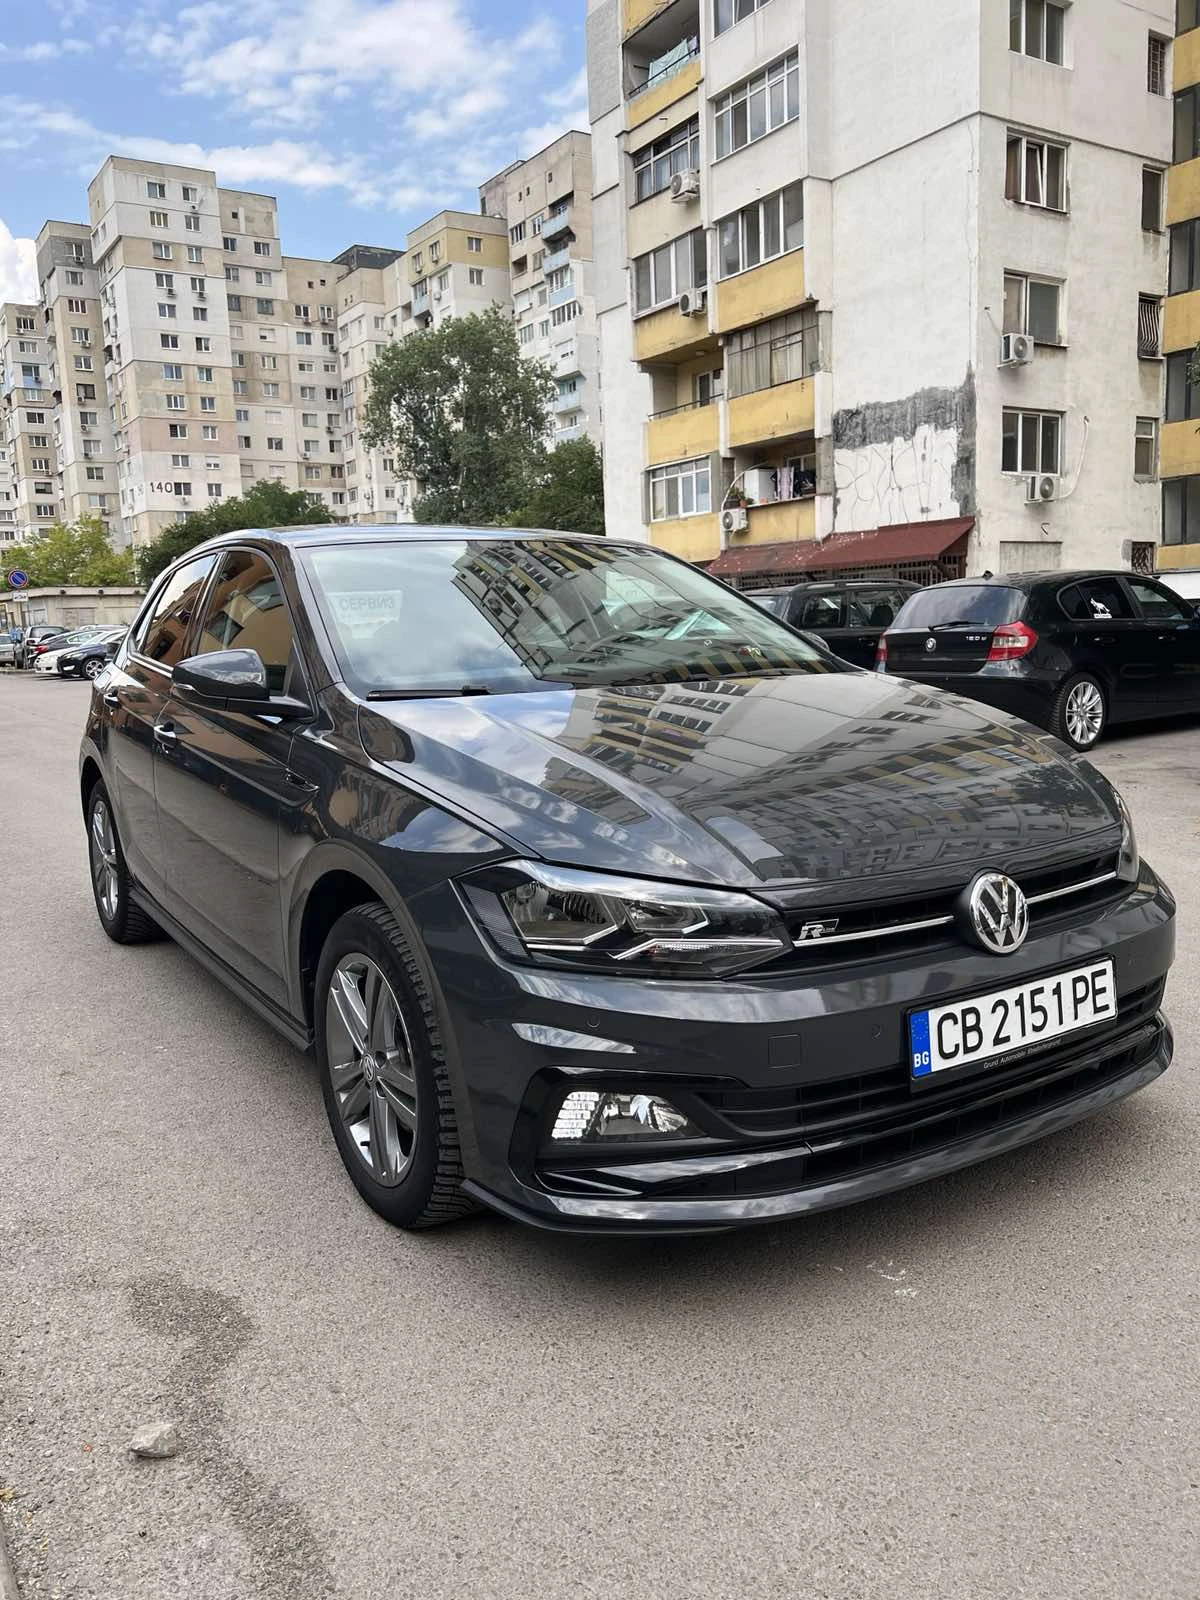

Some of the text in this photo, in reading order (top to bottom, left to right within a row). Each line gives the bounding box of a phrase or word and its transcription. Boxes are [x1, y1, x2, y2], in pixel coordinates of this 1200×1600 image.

[150, 482, 173, 493] 140
[937, 968, 1110, 1059] CB 2151 PE
[913, 1051, 930, 1067] BG
